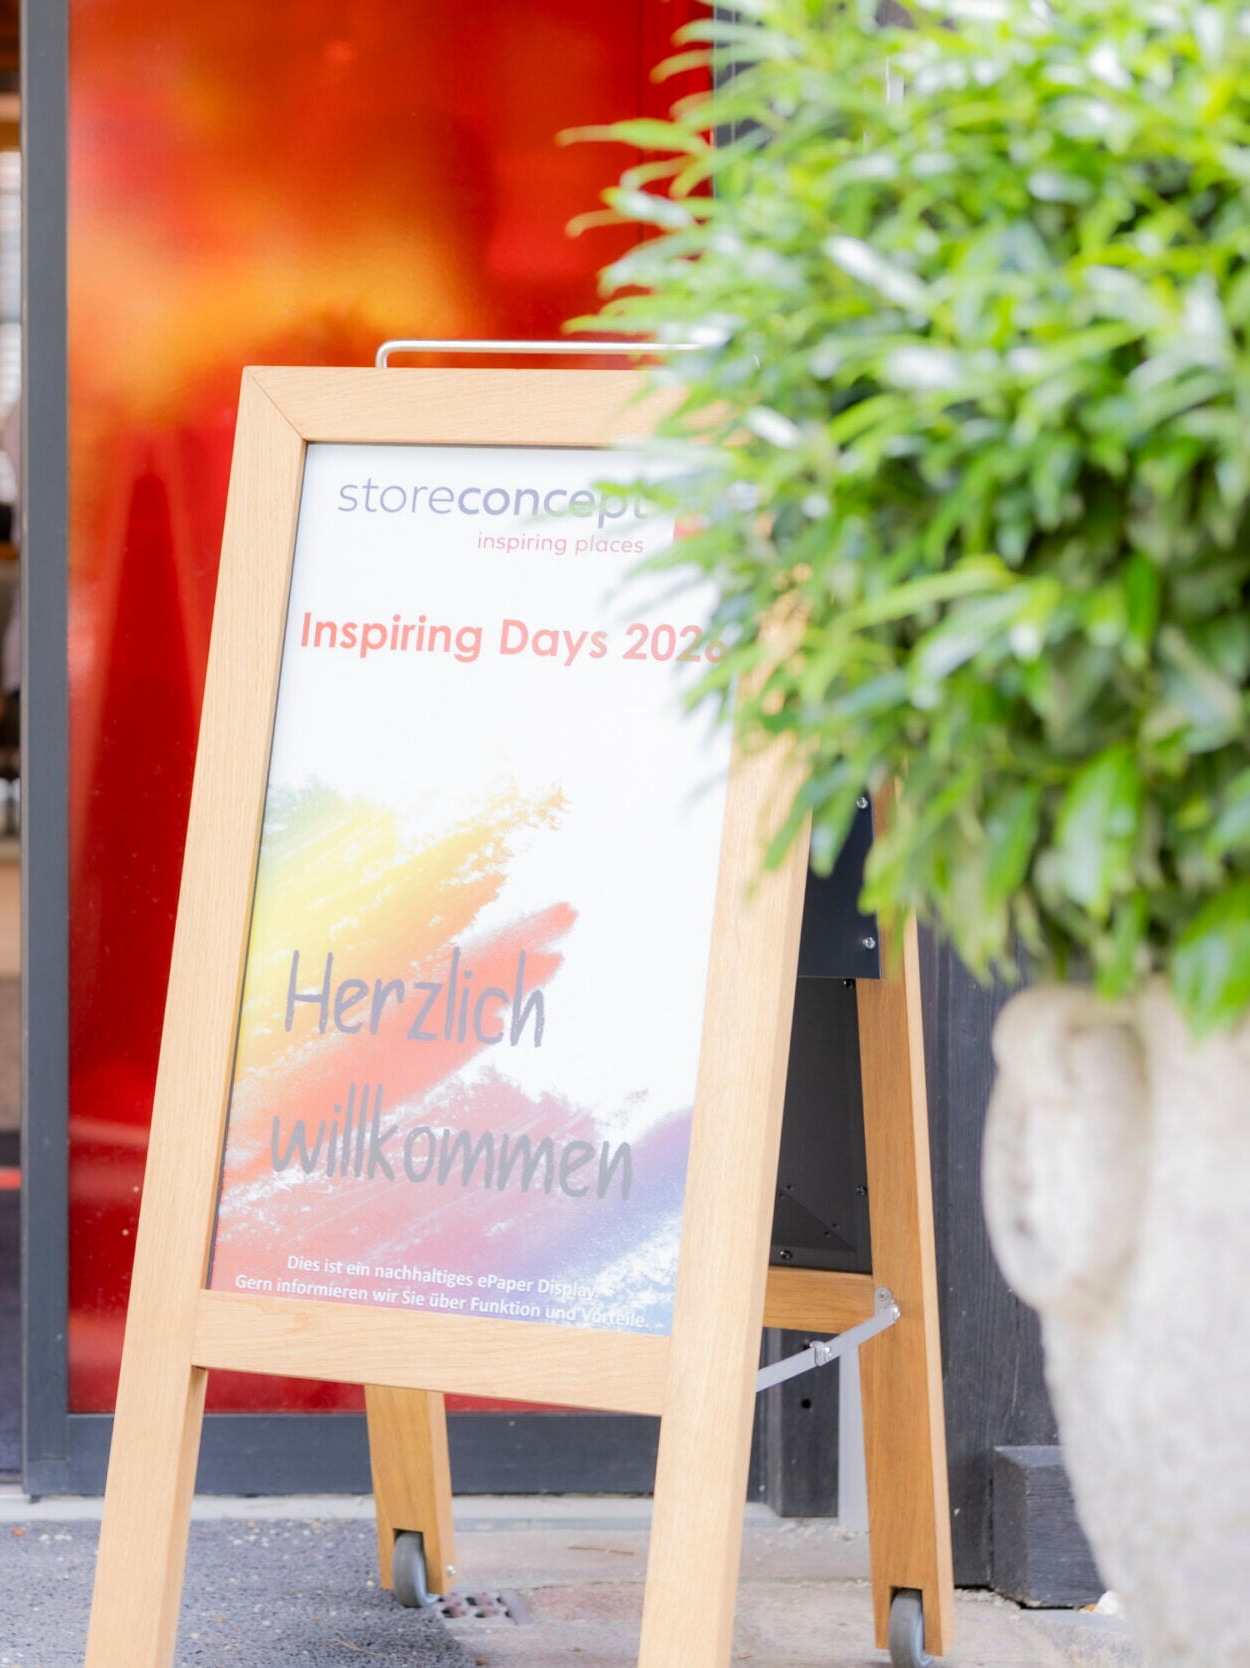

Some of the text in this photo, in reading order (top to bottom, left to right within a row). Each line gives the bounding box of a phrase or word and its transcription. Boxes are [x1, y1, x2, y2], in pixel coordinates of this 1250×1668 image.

[477, 531, 644, 556] inspiring places
[300, 611, 483, 663] Inspiring
[499, 618, 608, 666] Days
[284, 946, 546, 1047] Herzlich
[270, 1081, 633, 1201] willkommen
[235, 1273, 651, 1329] Gern informieren wir Sie über Funktion und Vorteile.
[287, 1254, 321, 1272] Dies
[324, 1258, 343, 1274] ist
[346, 1261, 370, 1276] ein
[375, 1264, 473, 1288] nachhaltiges
[477, 1273, 534, 1294] ePaper
